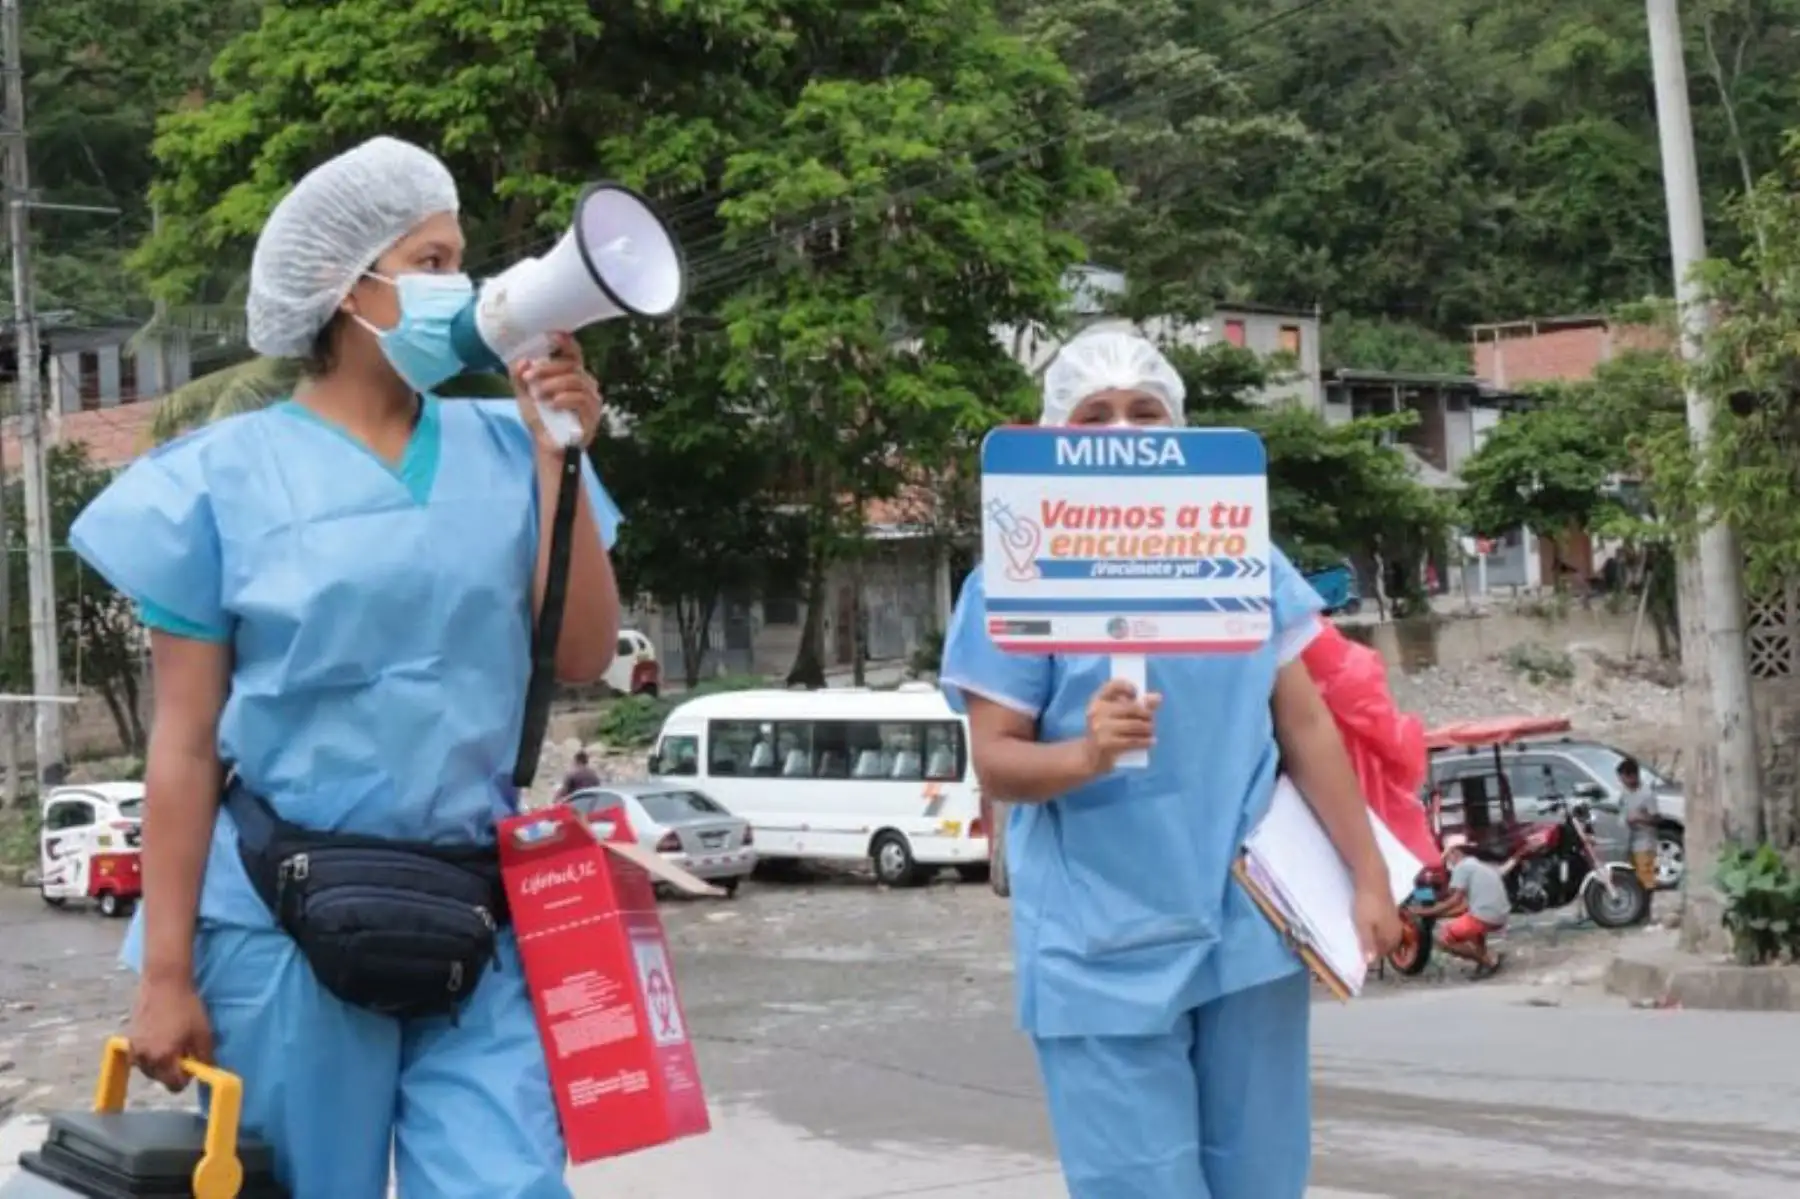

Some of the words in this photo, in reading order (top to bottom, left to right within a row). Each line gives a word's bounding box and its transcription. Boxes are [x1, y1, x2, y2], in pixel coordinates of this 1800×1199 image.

[1055, 436, 1186, 467] MINSA
[1040, 499, 1165, 529] Vamos
[1176, 504, 1200, 529] a
[1209, 501, 1253, 529] tu
[1050, 530, 1247, 558] encuentro
